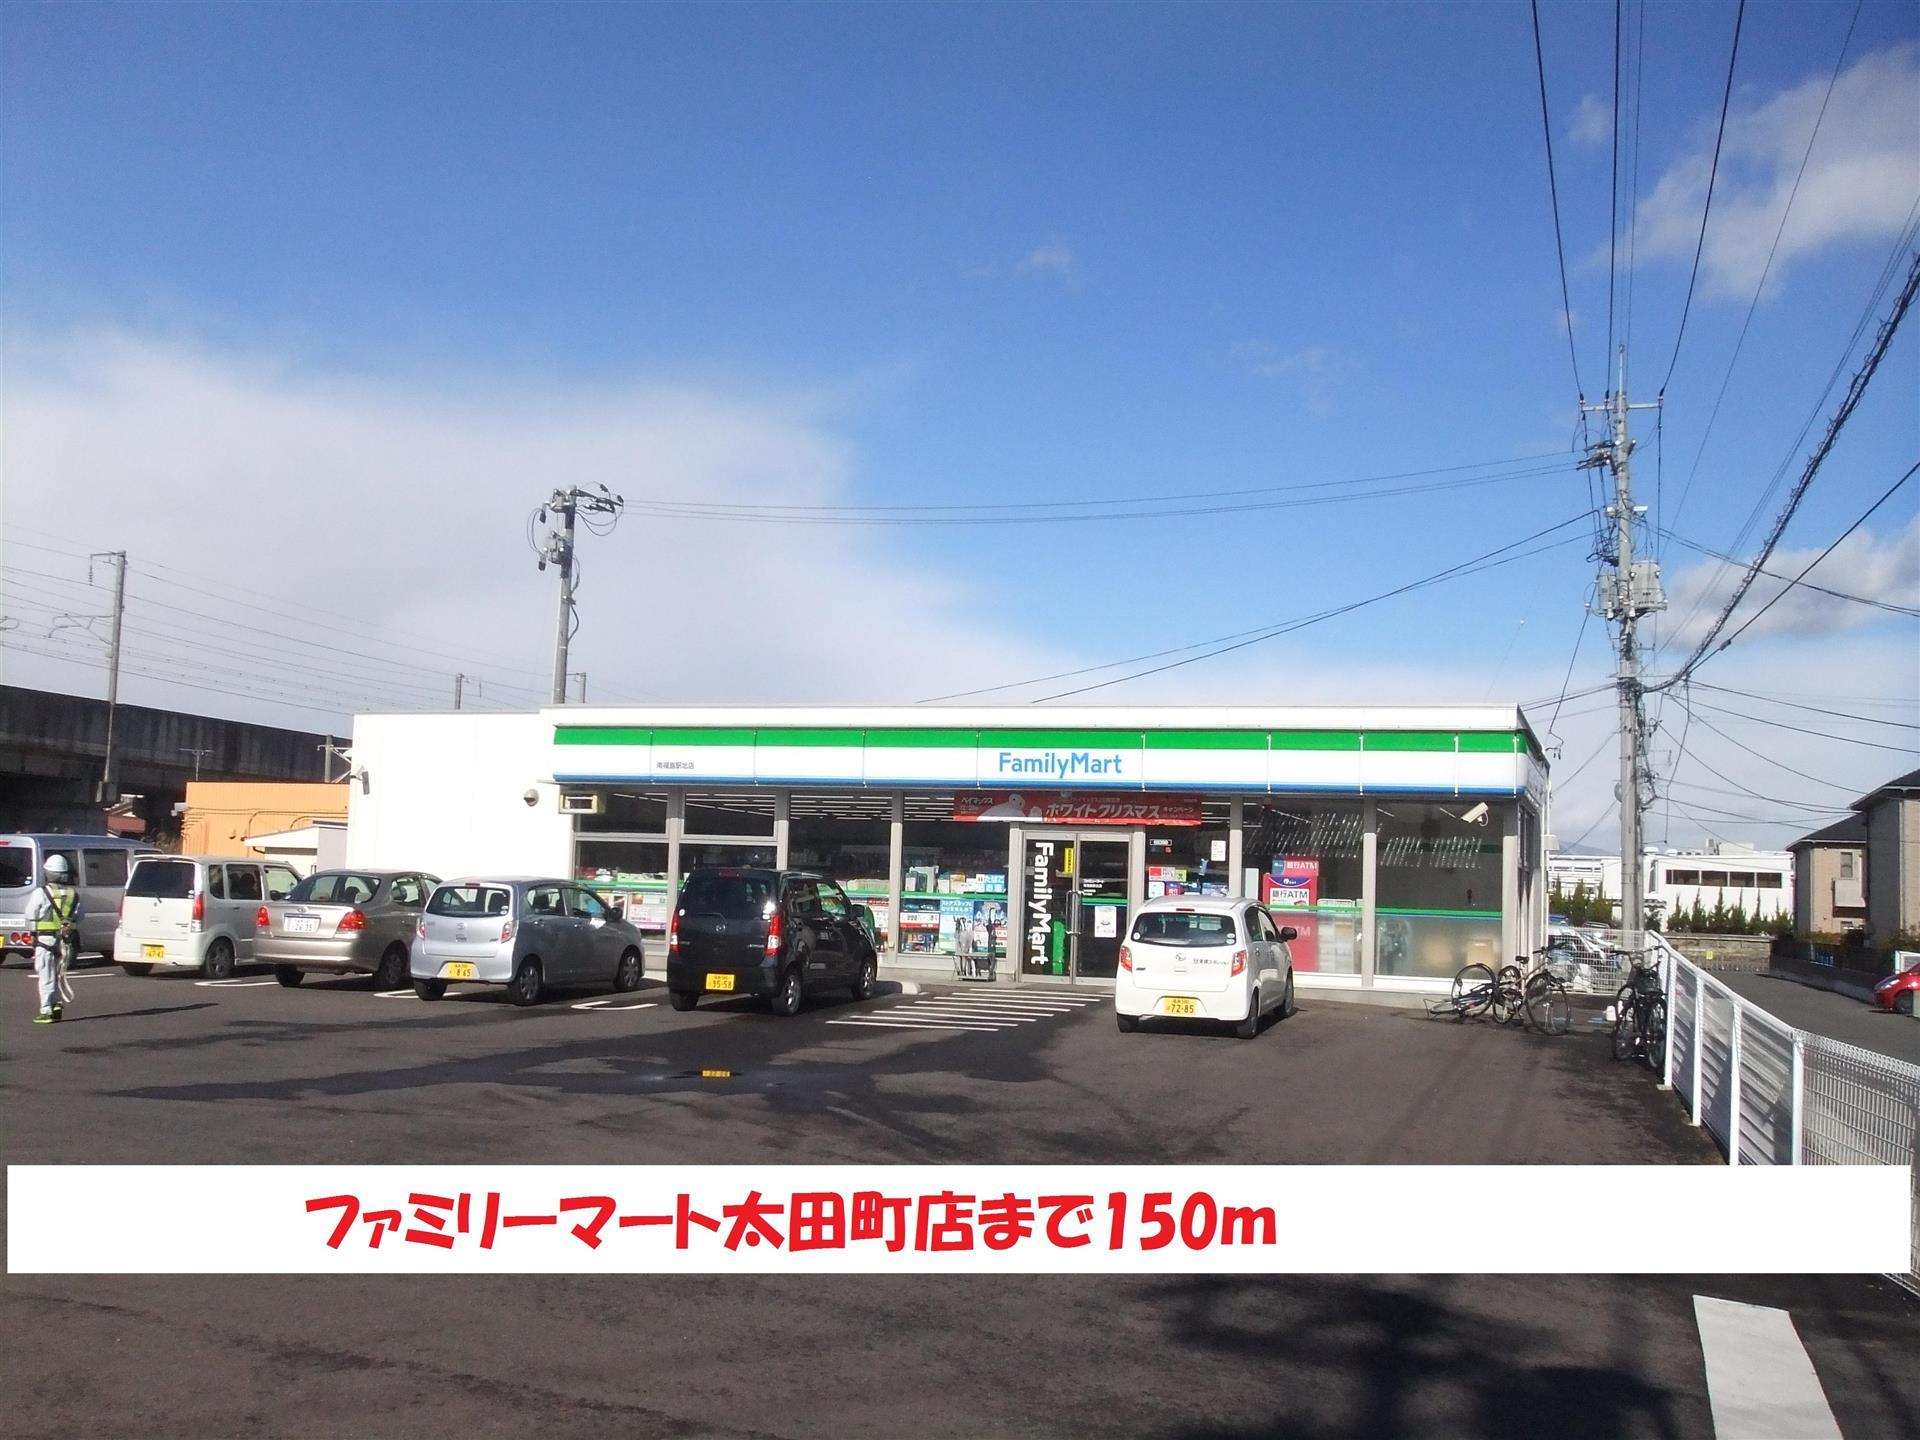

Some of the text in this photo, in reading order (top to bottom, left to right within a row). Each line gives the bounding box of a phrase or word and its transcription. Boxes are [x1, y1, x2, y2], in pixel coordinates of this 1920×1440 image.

[999, 752, 1122, 778] FamilyMart
[1046, 803, 1160, 818] ホワイトクリスマス
[1028, 842, 1054, 965] FamilyMart
[1170, 1004, 1195, 1014] 72-85
